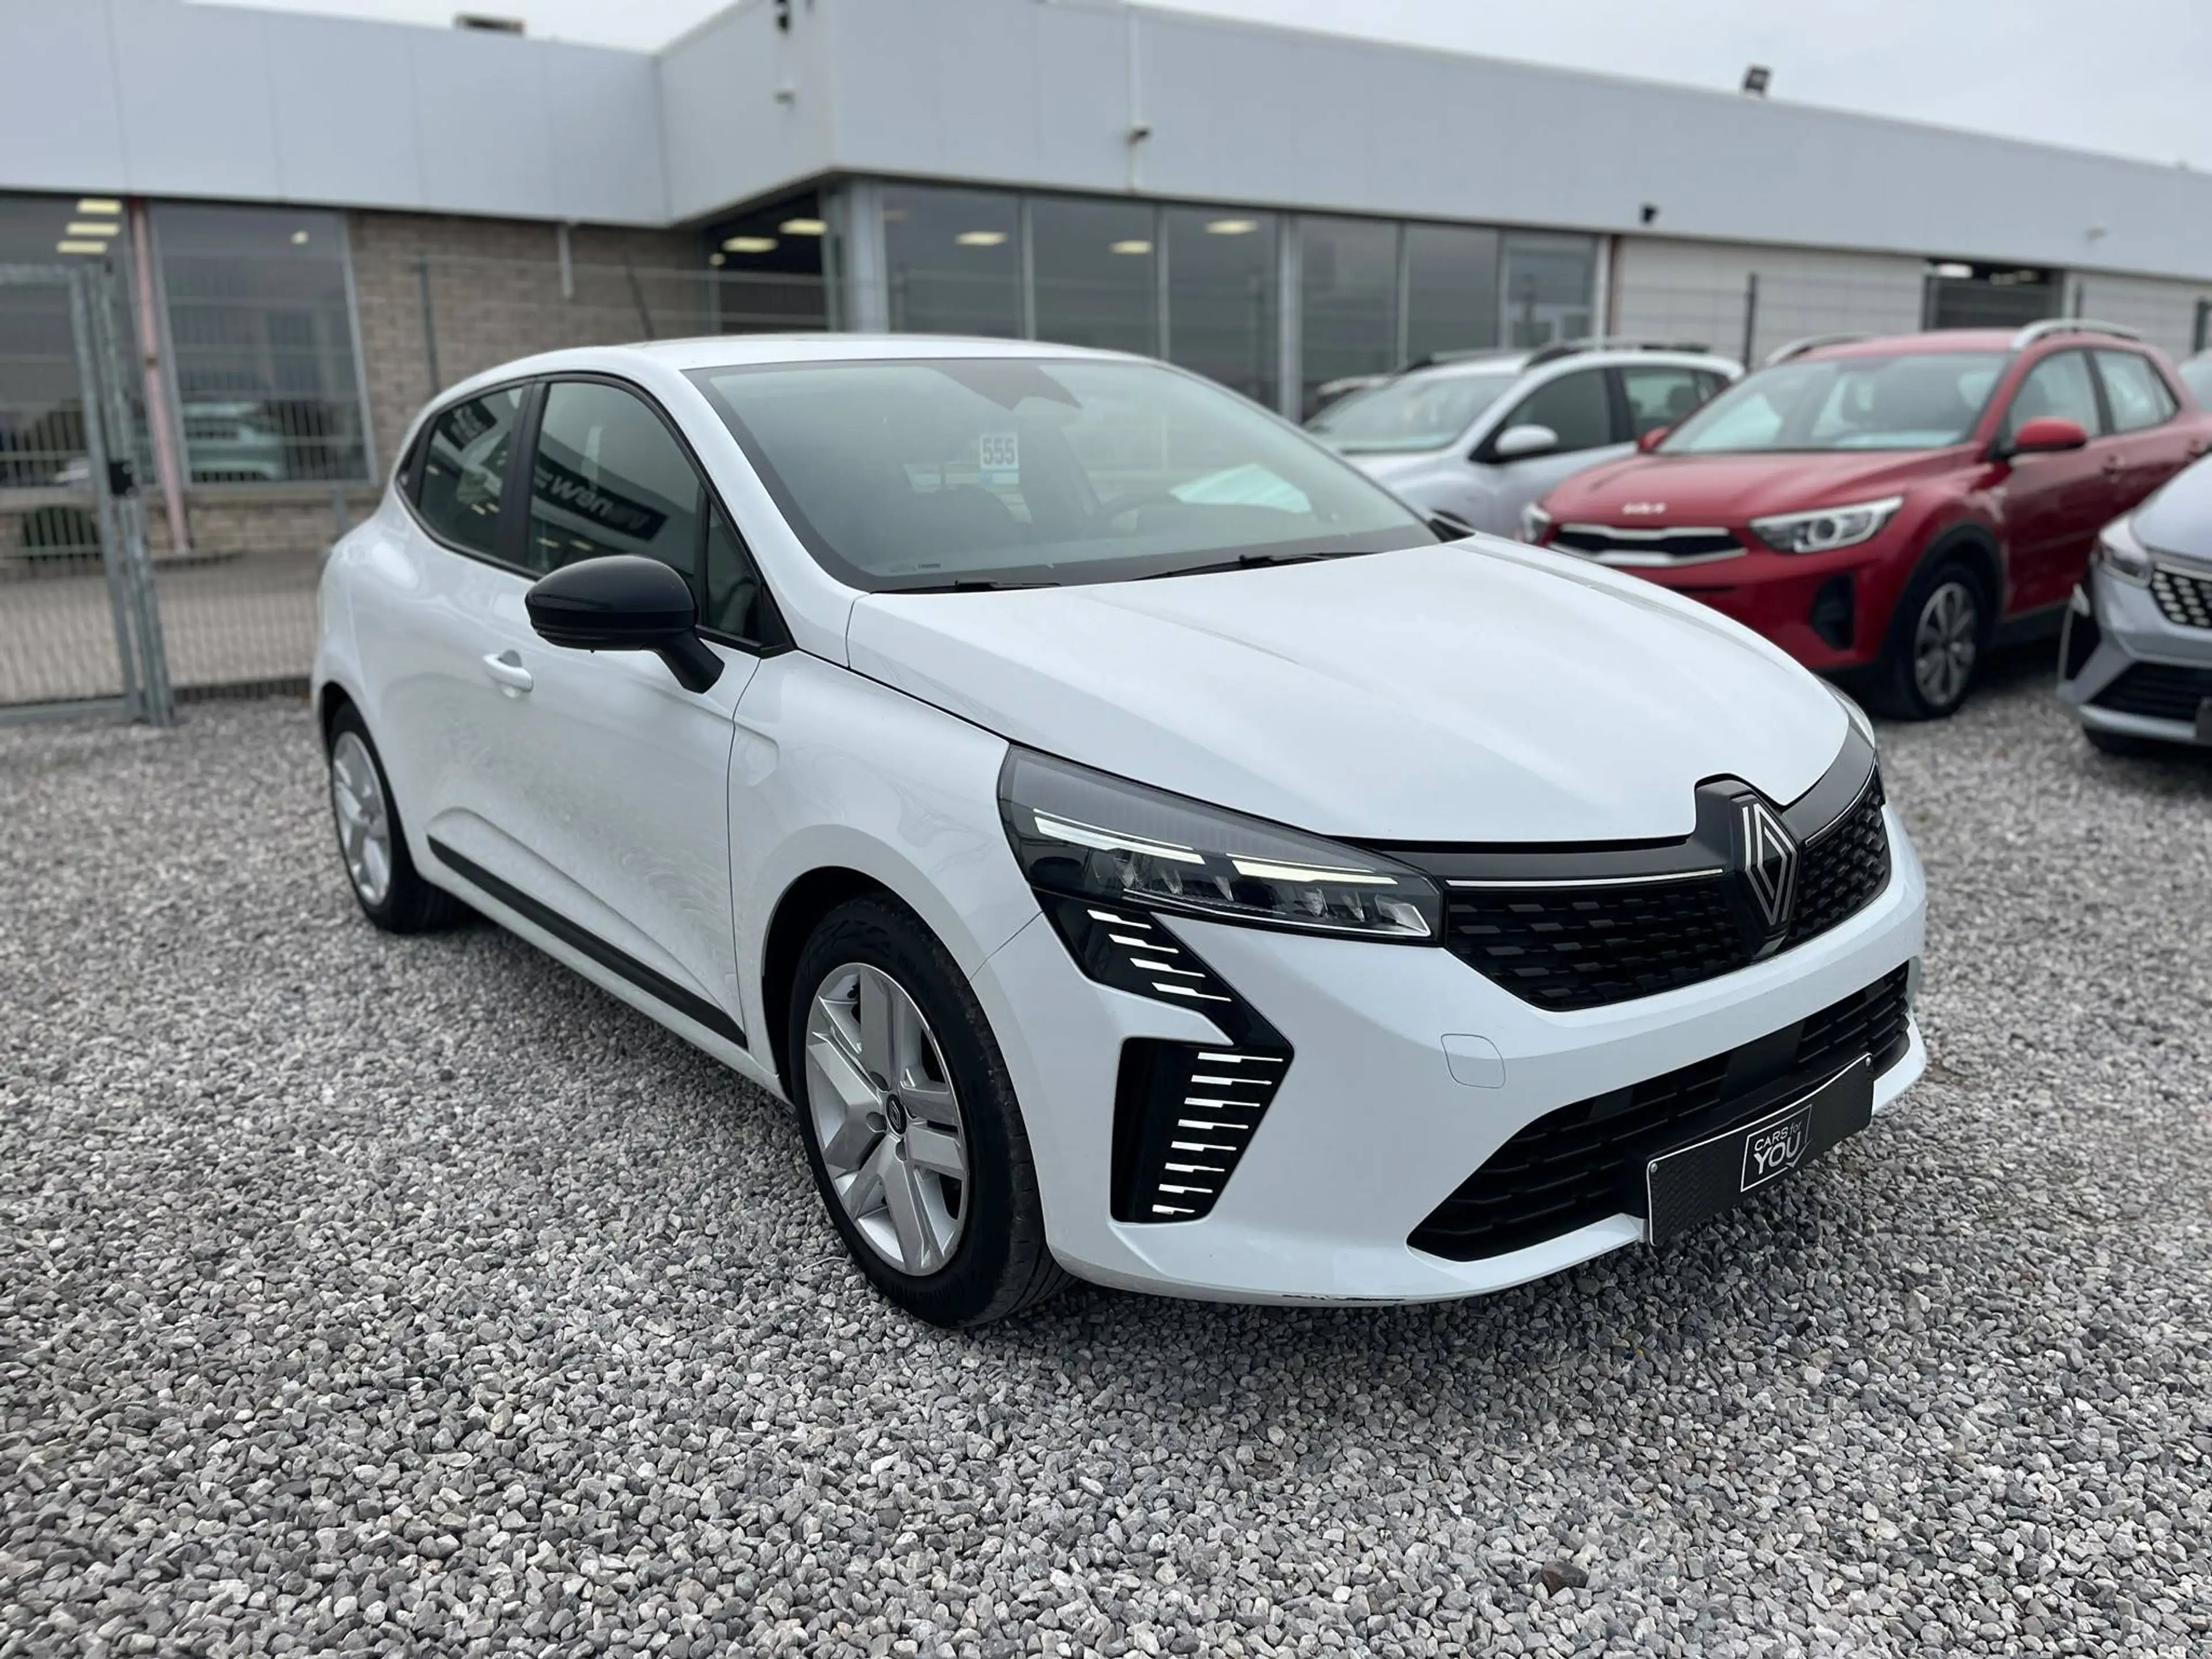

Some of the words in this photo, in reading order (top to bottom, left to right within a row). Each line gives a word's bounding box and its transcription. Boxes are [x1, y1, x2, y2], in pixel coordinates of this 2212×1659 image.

[983, 437, 1016, 465] 555
[1755, 1126, 1789, 1151] CARS
[1789, 1120, 1802, 1135] for
[1753, 1131, 1801, 1175] YOU
